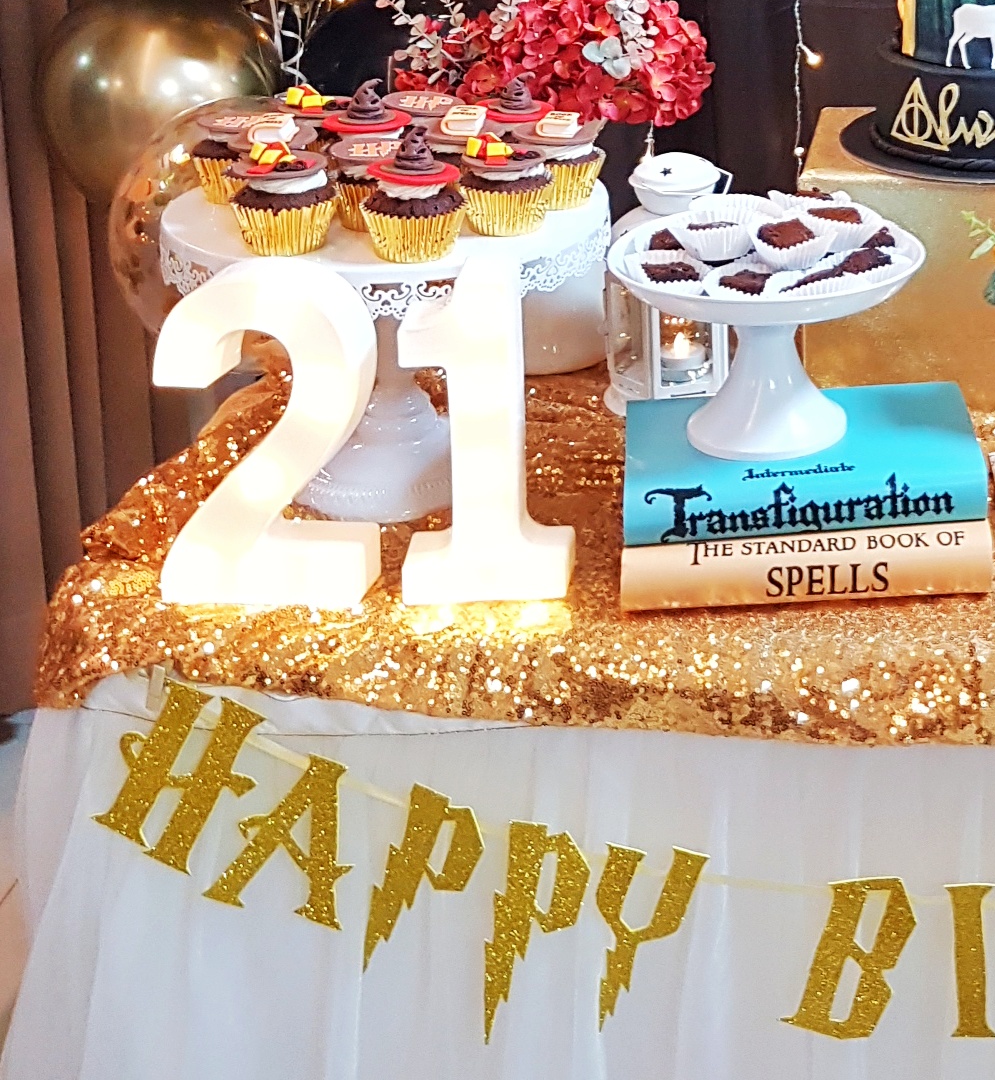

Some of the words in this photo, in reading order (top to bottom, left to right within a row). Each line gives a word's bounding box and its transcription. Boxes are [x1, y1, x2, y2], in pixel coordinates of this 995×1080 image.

[152, 256, 576, 610] 21
[742, 462, 856, 481] Intermediate
[644, 472, 956, 543] Transfiguration
[686, 541, 733, 566] THE
[741, 536, 856, 556] STANDARD
[867, 532, 930, 550] BOOK
[937, 531, 965, 547] OF
[765, 561, 890, 598] SPELLS
[90, 677, 711, 1045] HAPPY
